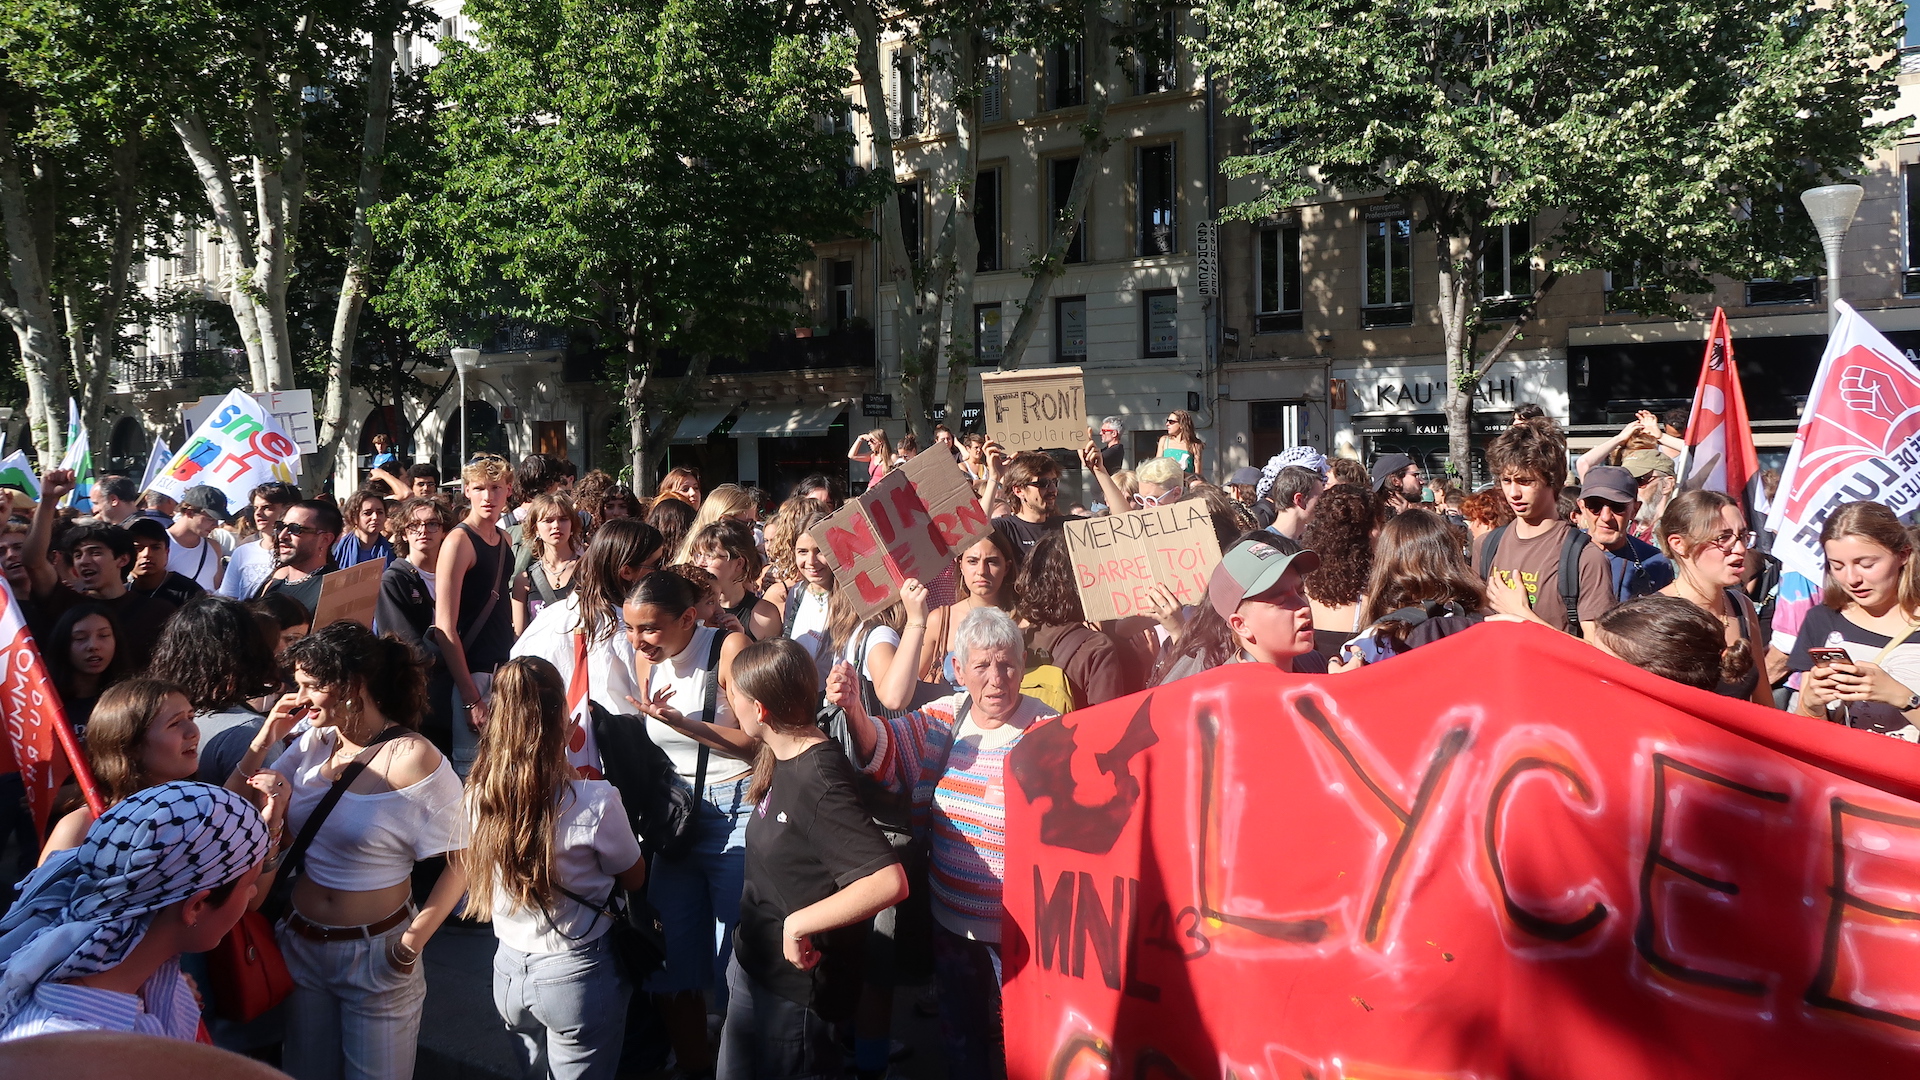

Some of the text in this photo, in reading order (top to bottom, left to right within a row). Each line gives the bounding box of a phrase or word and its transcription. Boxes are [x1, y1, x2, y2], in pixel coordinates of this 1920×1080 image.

[1365, 208, 1405, 219] Professionnel
[1197, 222, 1209, 295] ASSURANCES
[993, 385, 1083, 425] FRONT
[1156, 398, 1161, 406] 7
[996, 426, 1087, 446] populaire
[1315, 434, 1320, 442] 9
[825, 481, 931, 572] NIK
[1066, 506, 1209, 552] MERDELLA
[855, 498, 988, 606] LE RN
[1077, 555, 1152, 589] BARRE
[1033, 864, 1161, 1003] MNL
